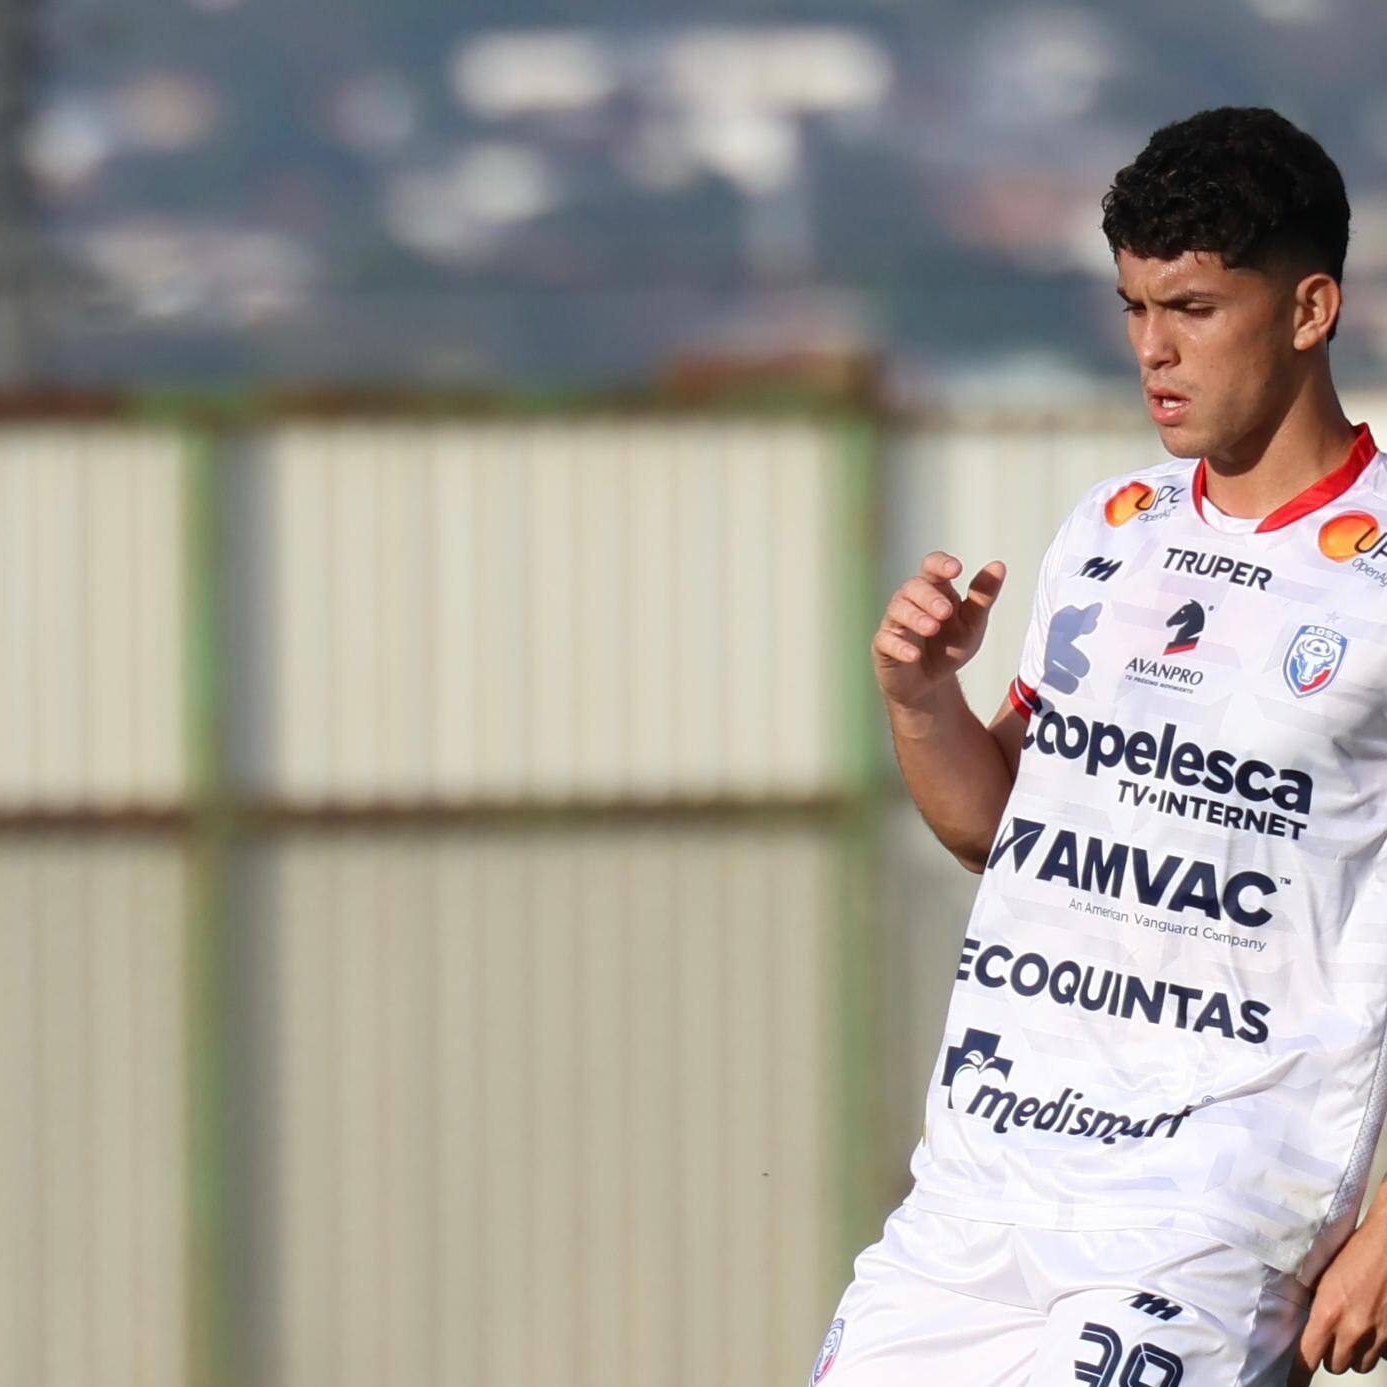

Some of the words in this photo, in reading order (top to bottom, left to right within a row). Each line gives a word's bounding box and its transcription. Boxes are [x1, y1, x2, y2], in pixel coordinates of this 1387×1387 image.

[1163, 547, 1273, 591] TRUPER
[1305, 624, 1342, 645] ADSC
[1124, 657, 1204, 686] AVANPRO
[1068, 897, 1084, 912] An
[1084, 903, 1129, 923] American
[1133, 912, 1199, 938] Vanguard
[1202, 926, 1267, 953] Company
[956, 937, 1272, 1044] ECOQUINTAS
[966, 1081, 1193, 1145] medismart
